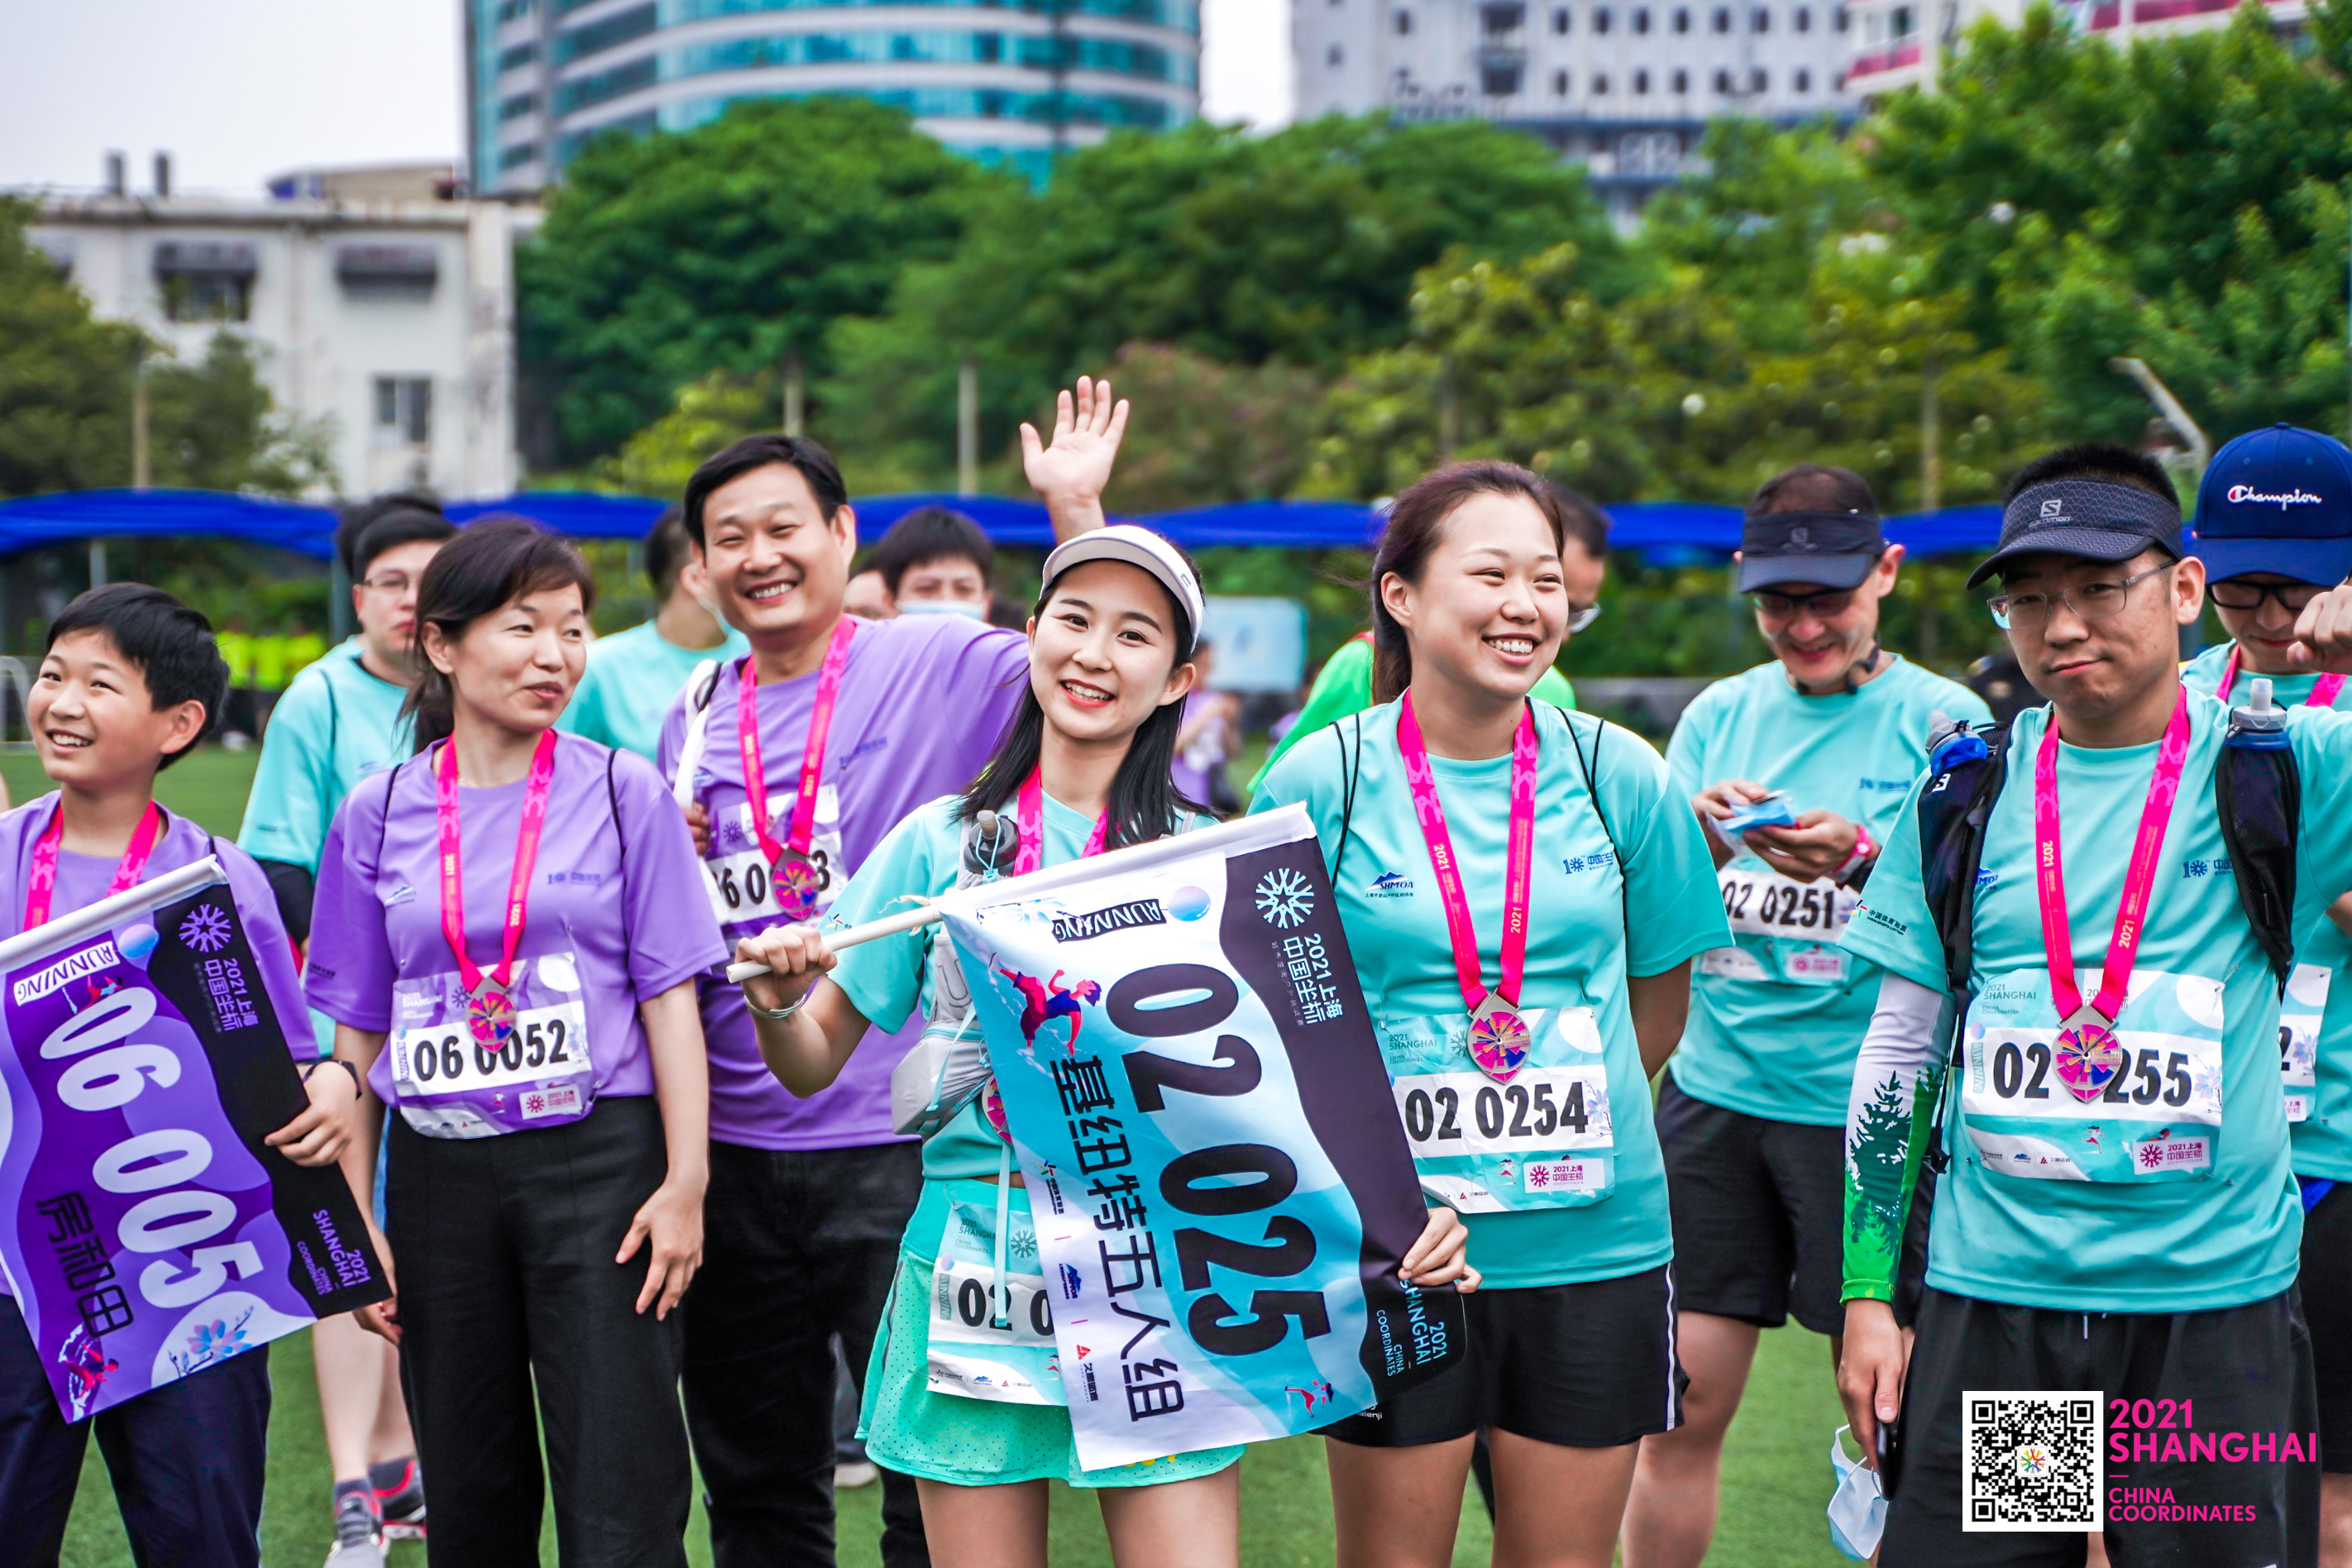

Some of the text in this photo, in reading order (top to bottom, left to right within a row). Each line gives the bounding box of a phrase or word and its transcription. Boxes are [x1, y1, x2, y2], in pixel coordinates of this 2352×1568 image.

[2227, 485, 2322, 511] Champion
[1434, 844, 1450, 870] 2021
[2043, 840, 2055, 868] 2021
[713, 868, 740, 908] 6
[1723, 881, 1834, 930] 02 0251
[1054, 901, 1162, 940] RUNNING
[1510, 906, 1523, 934] 2021
[2119, 920, 2135, 949] 2021
[17, 944, 114, 1002] RUNNING
[222, 958, 260, 1027] 2021 上海
[1284, 936, 1327, 1025] 中国坐标
[1304, 933, 1343, 1019] 2021 上海
[1986, 983, 2005, 992] 2021
[203, 958, 244, 1031] 中国坐标
[1984, 991, 2037, 1000] SHANGHAI
[414, 1019, 568, 1082] 06 0052
[1389, 1033, 1408, 1042] 2021
[1389, 1040, 1437, 1050] SHANGHAI
[1972, 1042, 1985, 1093] RUNNING
[1993, 1042, 2192, 1107] 02 255
[1405, 1081, 1589, 1142] 02 0254
[40, 987, 265, 1308] 06 005
[1106, 963, 1331, 1356] 02 025
[2167, 1150, 2203, 1160] 中国坐标
[2168, 1143, 2187, 1152] 2021
[960, 1218, 978, 1229] 2021
[1049, 1054, 1184, 1422] 基纽特五人组
[36, 1191, 134, 1338] 房和田
[313, 1209, 356, 1287] SHANGHAI
[346, 1250, 371, 1284] 2021
[1399, 1279, 1432, 1365] SHANGHAI
[1429, 1322, 1447, 1360] 2021
[1376, 1309, 1397, 1377] COORDINATES
[1394, 1344, 1405, 1374] CHINA
[1357, 1410, 1383, 1421] alenji
